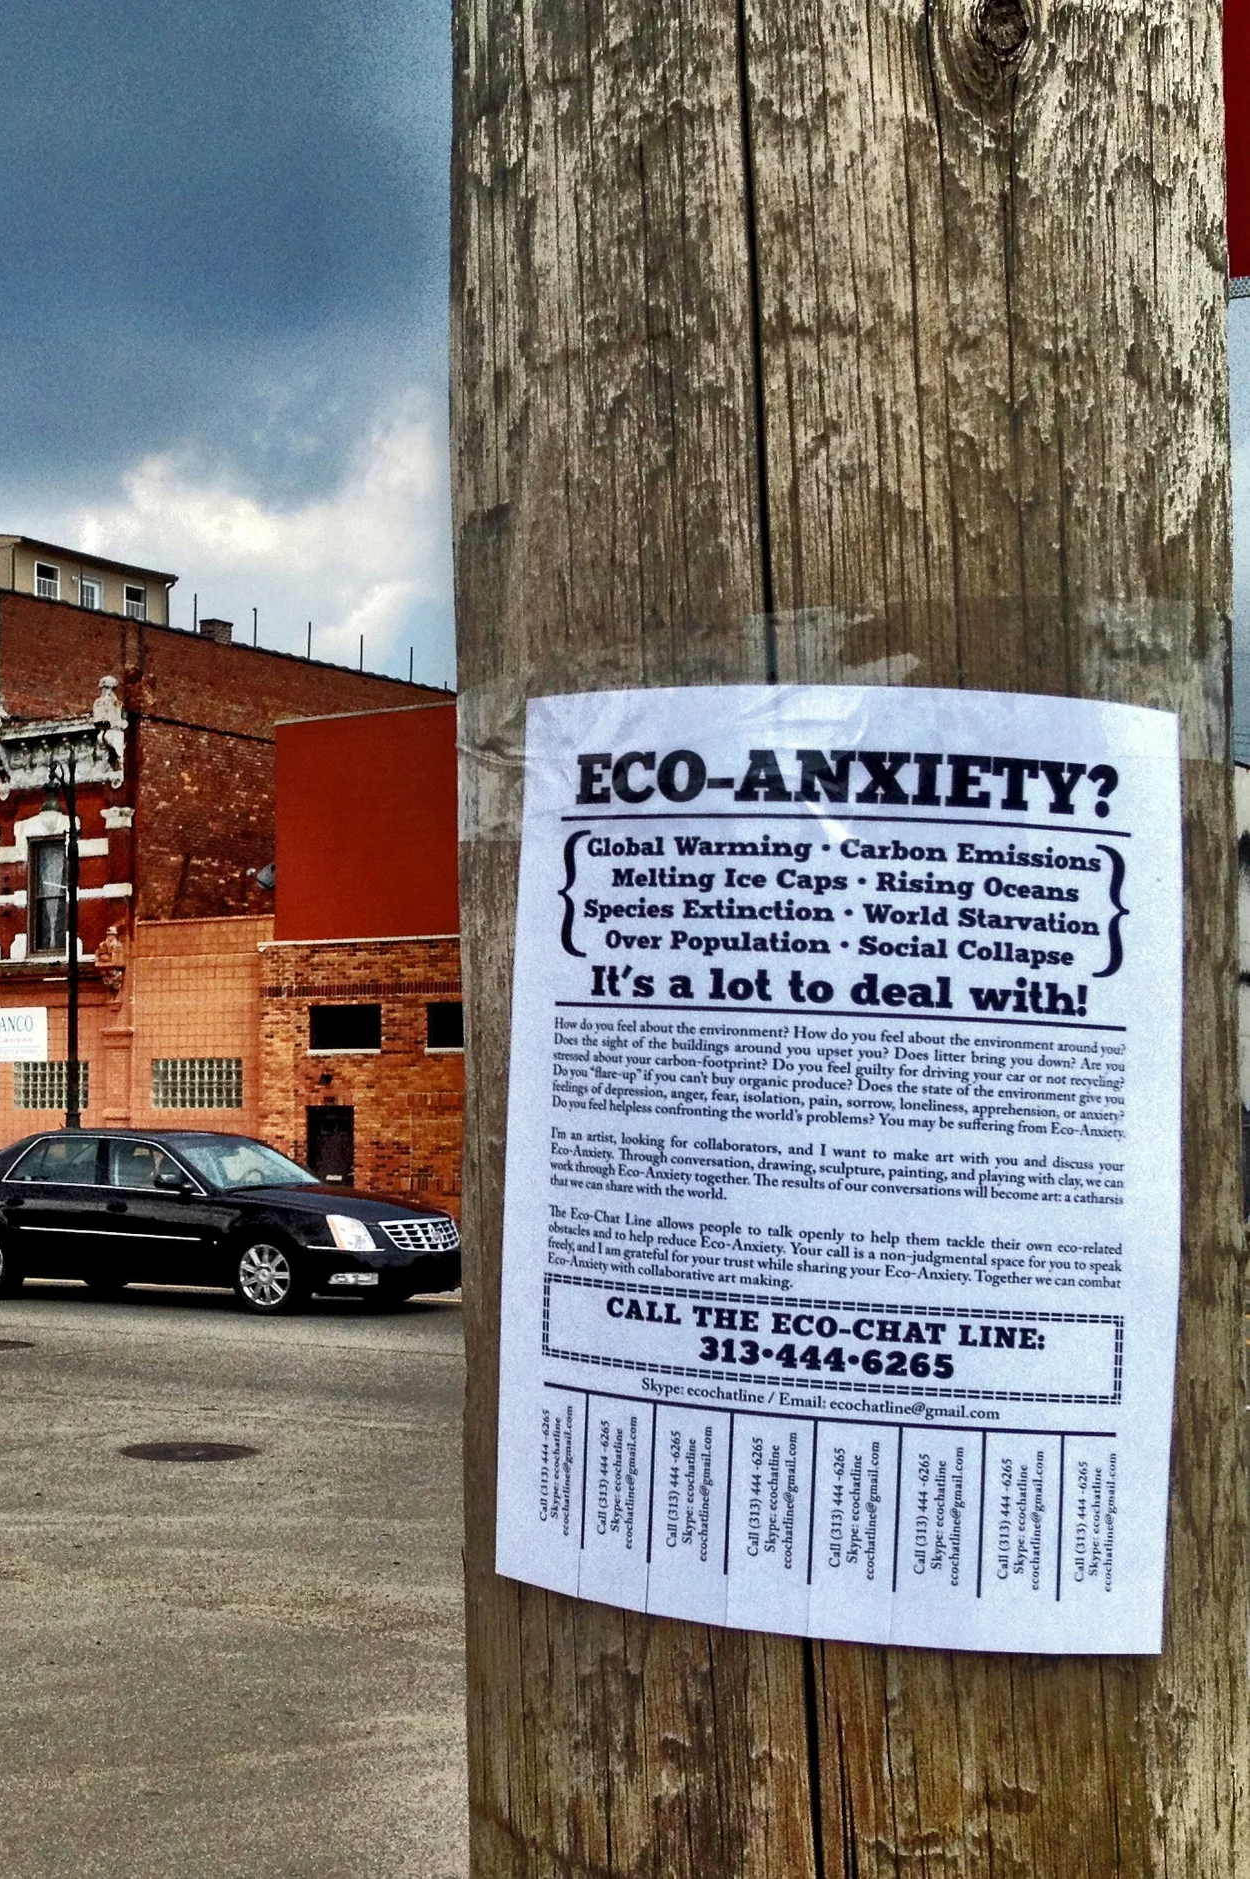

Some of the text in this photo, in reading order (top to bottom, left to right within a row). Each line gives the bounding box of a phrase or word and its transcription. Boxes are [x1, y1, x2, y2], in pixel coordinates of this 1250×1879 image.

[576, 749, 1119, 817] ECO-ANXIETY?
[587, 833, 1101, 872] Global Warming Carbon Emissions
[611, 866, 1079, 902] Melting Ice Caps Rising Oceans
[584, 897, 1100, 935] Species Extinction World Starvation
[605, 930, 1074, 968] Over Population Social Collapse
[668, 975, 694, 998] a
[708, 968, 772, 1001] lot
[788, 971, 834, 1003] to
[850, 973, 953, 1008] deal
[968, 977, 1087, 1016] with!
[554, 1017, 1126, 1058] How do you feel about the environment? How do you feel about the environment around you?
[554, 1032, 1126, 1075] Does the sight of the buildings around you upset you? Does litter bring you down? Are you
[552, 1048, 1125, 1091] stressed about your carbon-footprint? Do you feel guilty for driving your car or not recycling?
[570, 1132, 582, 1140] an
[586, 1129, 617, 1146] artist,
[620, 1132, 666, 1149] looking
[670, 1135, 689, 1147] for
[693, 1136, 782, 1156] collaborators,
[787, 1142, 814, 1155] and
[820, 1143, 826, 1155] I
[832, 1144, 867, 1157] want
[872, 1146, 887, 1159] to
[892, 1148, 930, 1161] make
[934, 1150, 955, 1162] art
[959, 1151, 990, 1164] with
[995, 1157, 1018, 1169] you
[1023, 1155, 1047, 1167] and
[1052, 1156, 1094, 1170] discuss
[1098, 1162, 1125, 1175] your
[550, 1205, 1123, 1255] The Eco-Chat Line allows people to talk openly to help them tackle their own eco-related
[606, 1297, 1045, 1350] CALL THE ECO-CHAT LINE:
[641, 1377, 684, 1396] Skype:
[686, 1382, 765, 1401] ecochatline
[779, 1391, 826, 1406] Email:
[829, 1395, 1000, 1421] ecochatline@gmail.com
[668, 1491, 680, 1520] (313)
[682, 1439, 696, 1544] Skype: ecochatline
[698, 1426, 713, 1562] ecochatline@gmail.com
[749, 1498, 763, 1528] (313)
[764, 1445, 779, 1552] Skype: ecochatline
[782, 1432, 798, 1569] ecochatline@gmail.com
[846, 1455, 862, 1563] Skype: ecochatline
[864, 1442, 881, 1580] ecochatline@gmail.com
[666, 1524, 677, 1547] Call
[831, 1510, 844, 1540] (313)
[916, 1516, 929, 1546] (313)
[931, 1460, 946, 1569] Skype: ecochatline
[949, 1447, 965, 1586] ecochatline@gmail.com
[747, 1532, 759, 1556] Call
[829, 1543, 841, 1567] Call
[914, 1551, 925, 1574] Call
